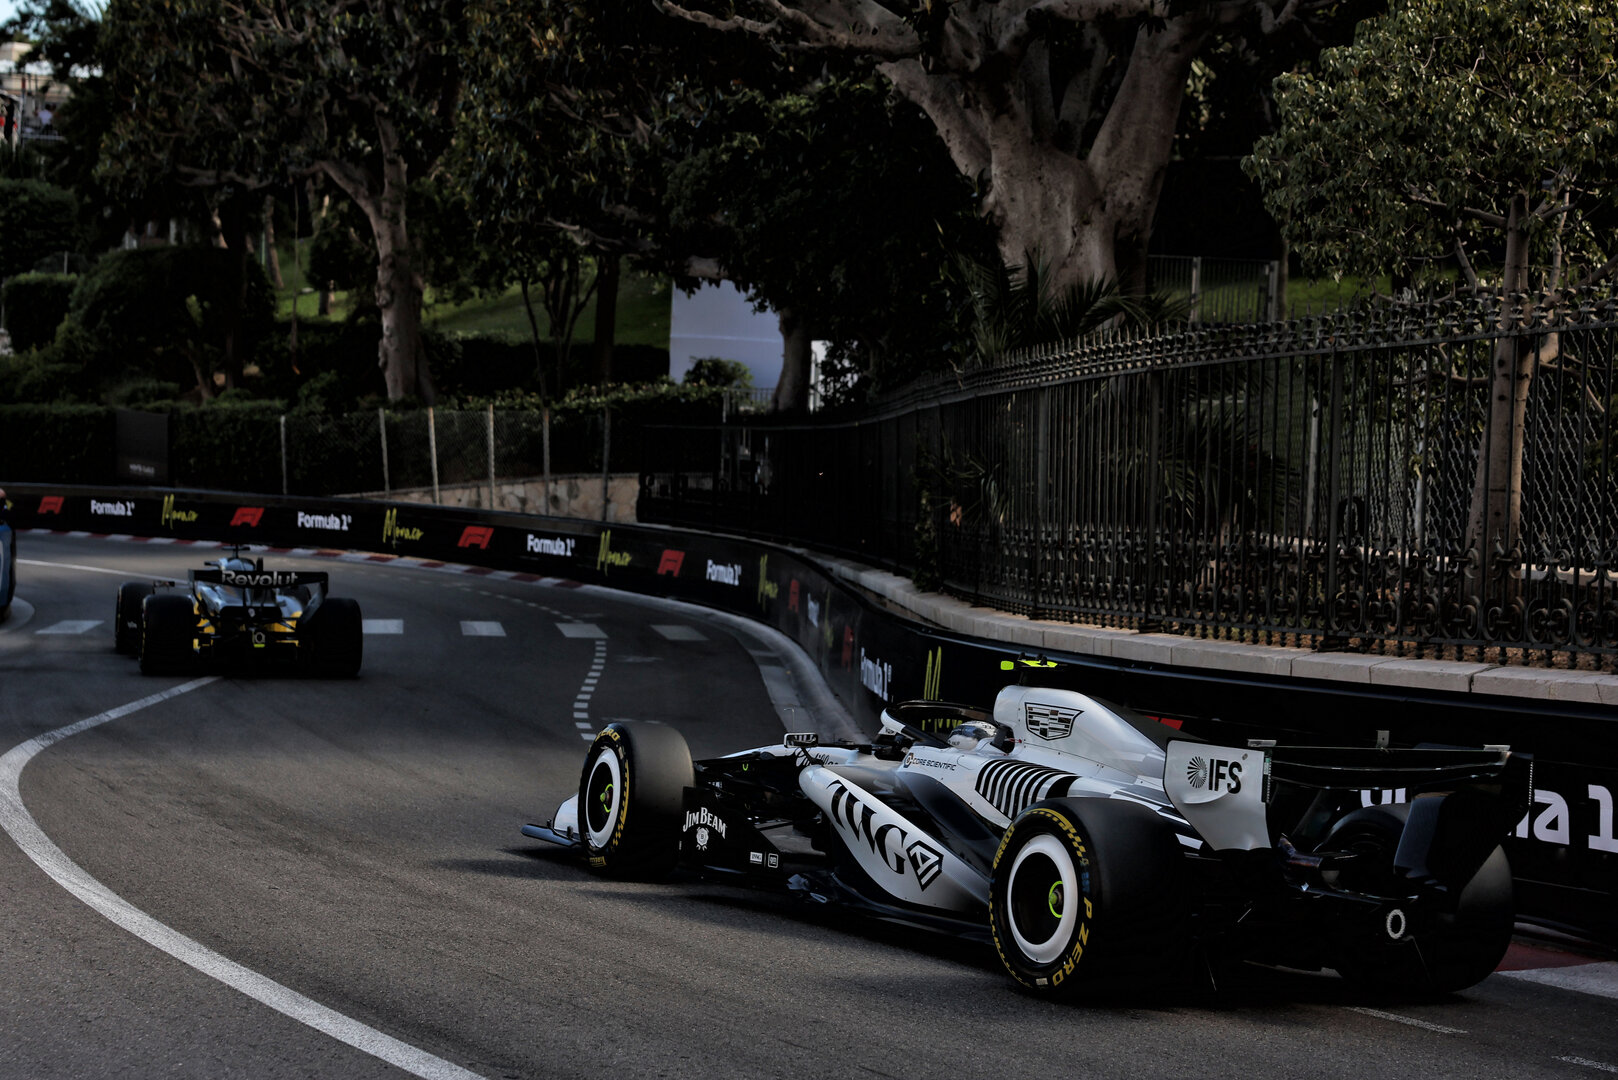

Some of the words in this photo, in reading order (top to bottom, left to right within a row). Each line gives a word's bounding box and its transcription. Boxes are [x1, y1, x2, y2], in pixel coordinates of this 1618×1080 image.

[91, 499, 127, 516] Formula
[297, 511, 341, 531] Formula
[526, 533, 566, 556] Formula
[221, 571, 298, 587] Revolut
[912, 757, 927, 766] CORE
[926, 759, 957, 771] SCIENTIFIC
[1208, 758, 1243, 795] IFS
[682, 810, 700, 833] JIM
[699, 806, 728, 840] BEAM
[1083, 896, 1094, 919] P
[1051, 921, 1091, 987] ZERO
